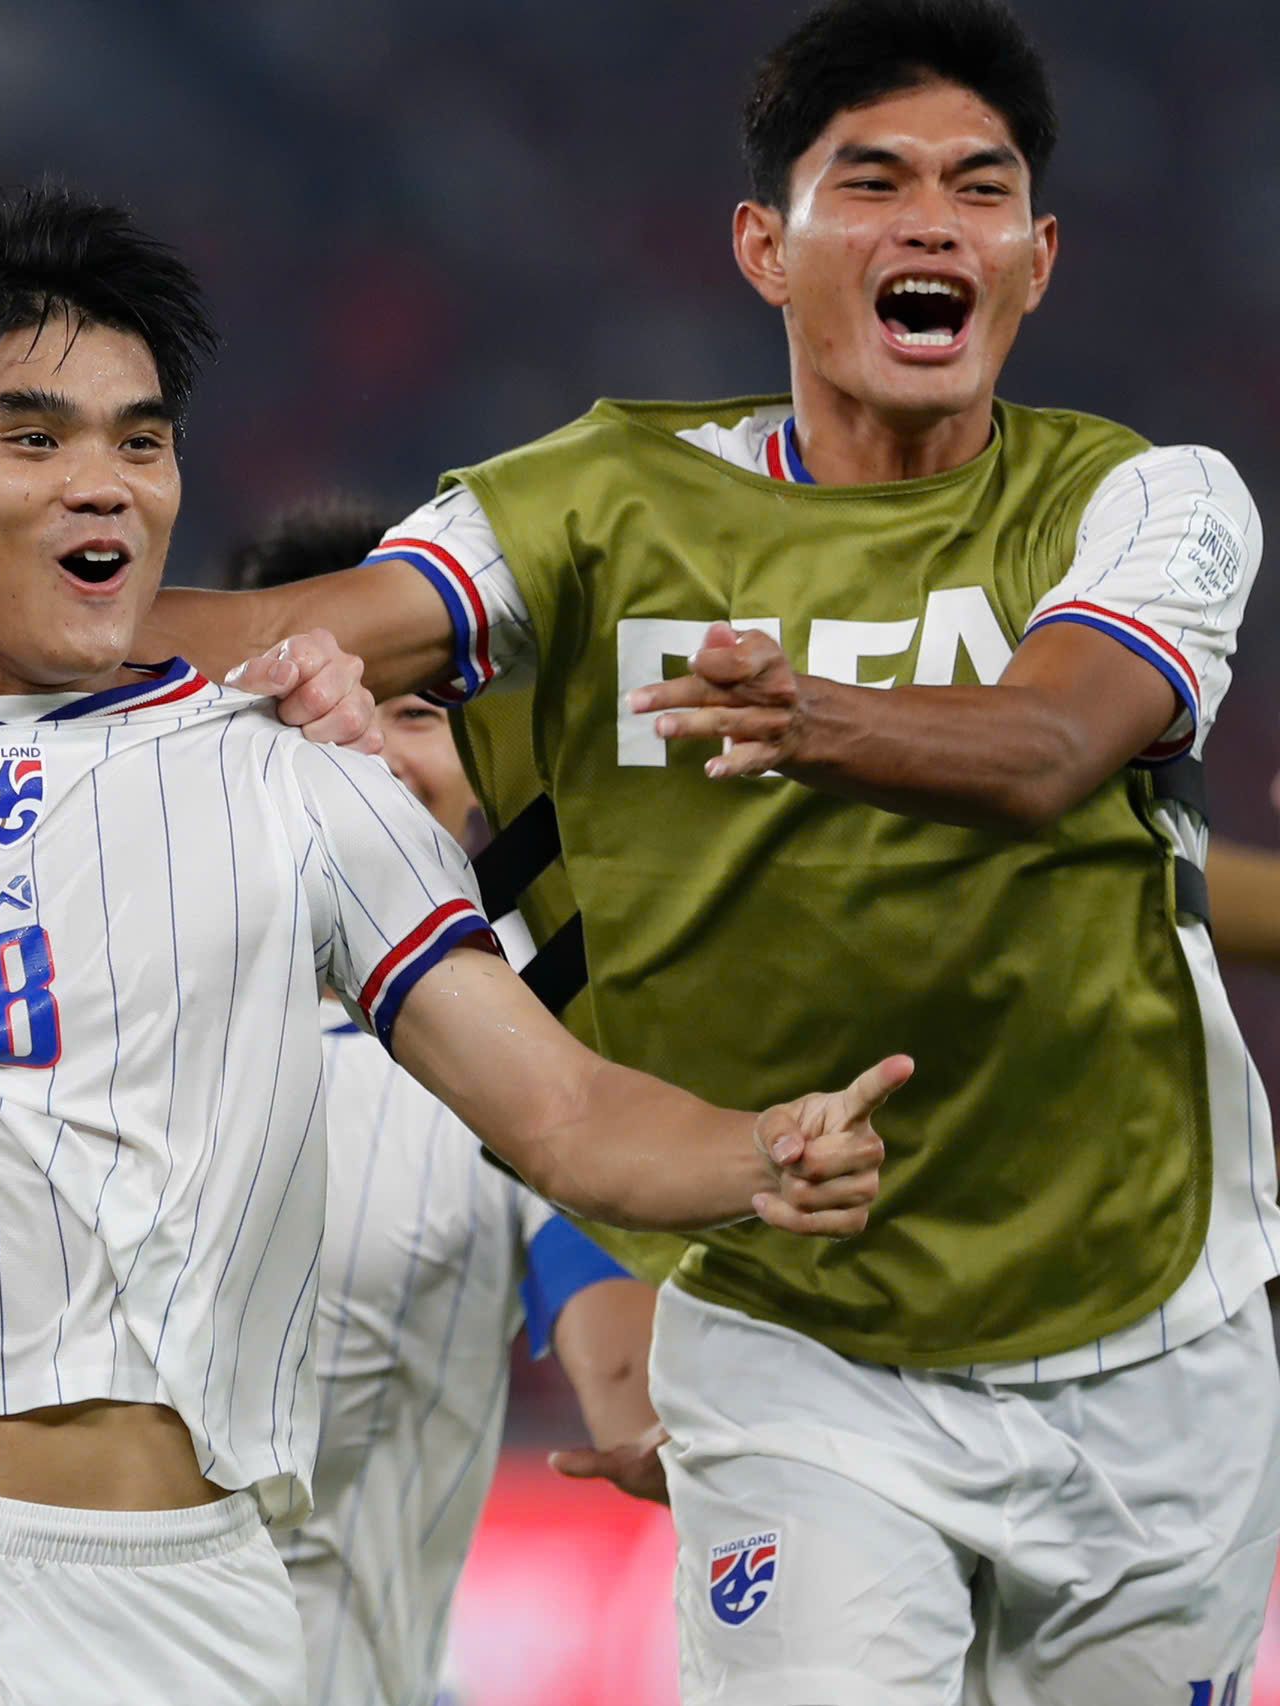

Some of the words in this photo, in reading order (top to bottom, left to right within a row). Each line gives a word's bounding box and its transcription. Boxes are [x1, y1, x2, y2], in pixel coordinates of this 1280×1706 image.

[1204, 513, 1241, 569] FOOTBALL
[1188, 548, 1207, 570] the
[1198, 528, 1237, 585] UNITES
[1194, 575, 1213, 597] FIFA
[712, 1533, 776, 1558] THAILAND
